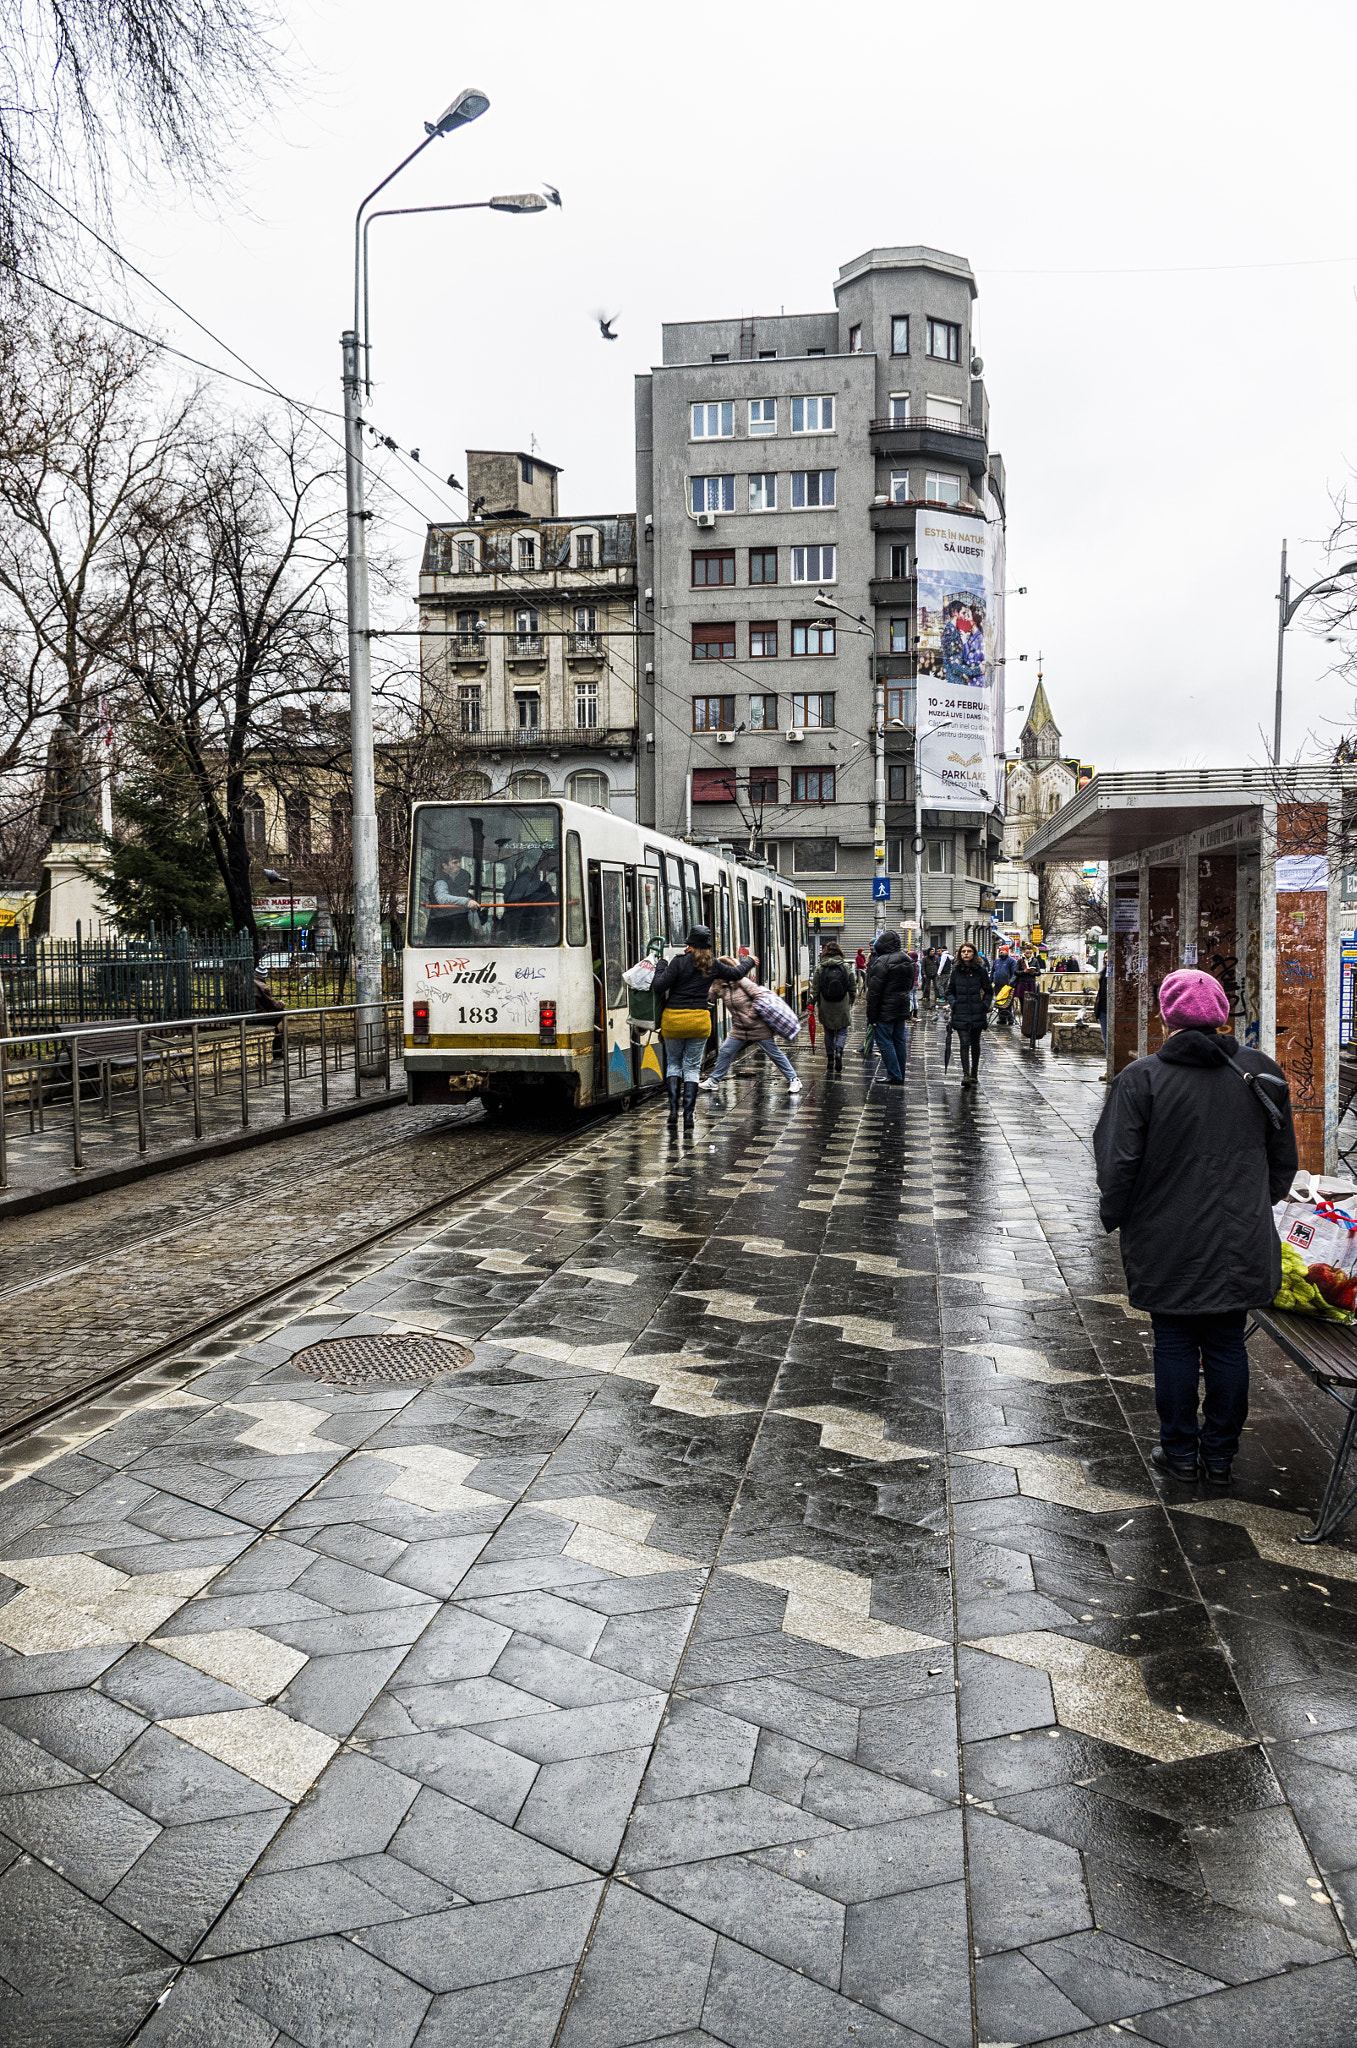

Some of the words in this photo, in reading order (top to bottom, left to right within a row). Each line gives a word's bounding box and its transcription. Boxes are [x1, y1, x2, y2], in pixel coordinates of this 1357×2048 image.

[924, 527, 946, 539] ESTE
[948, 528, 957, 540] ÎN
[944, 541, 955, 553] SĂ
[928, 697, 938, 707] 10
[945, 699, 955, 708] 24
[941, 769, 986, 781] PARKLAKE
[825, 899, 842, 914] GSM
[458, 1006, 498, 1024] 183
